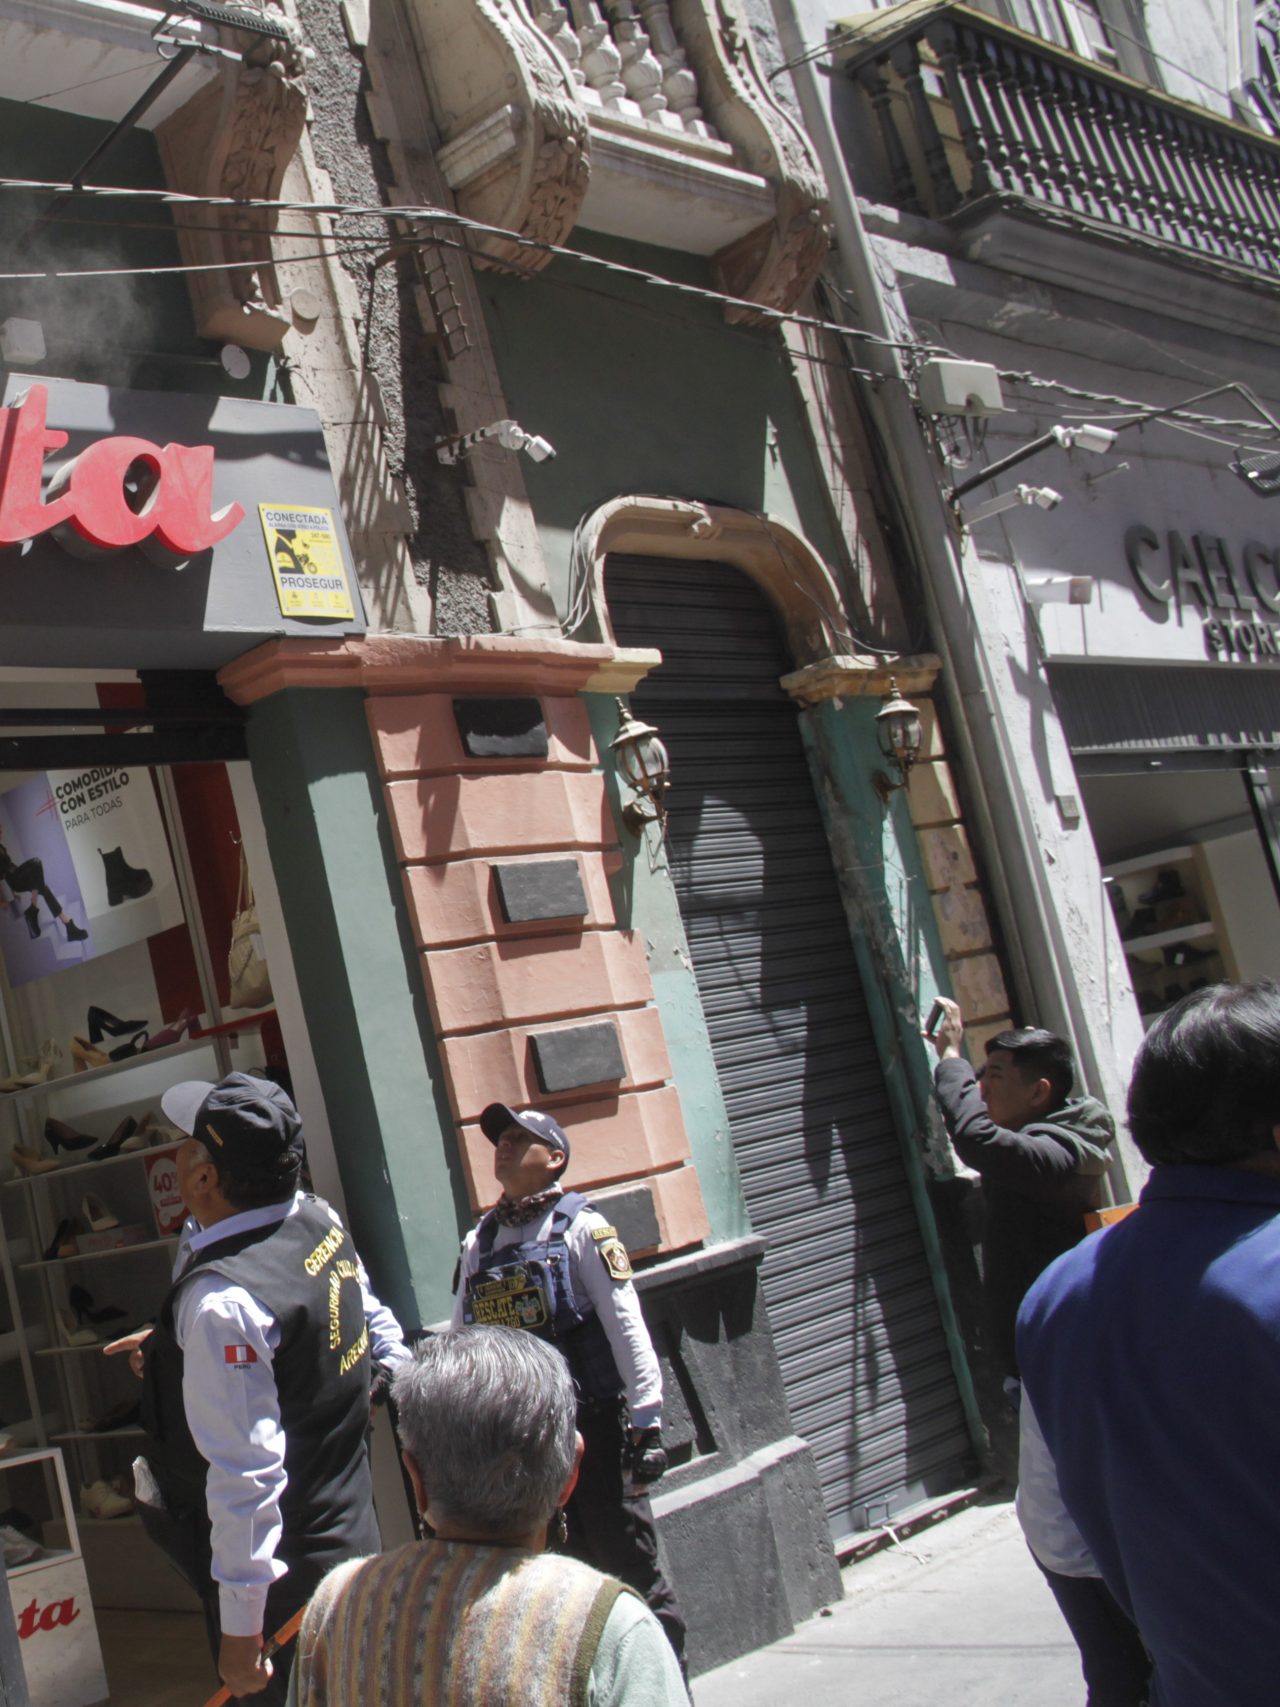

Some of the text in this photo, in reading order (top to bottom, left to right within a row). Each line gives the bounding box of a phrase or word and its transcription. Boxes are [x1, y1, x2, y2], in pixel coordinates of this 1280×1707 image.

[265, 511, 328, 526] CONECTADA
[280, 576, 344, 591] PROSEGUR
[1123, 524, 1280, 618] CAELC
[61, 772, 129, 814] CON ESTILO
[65, 796, 123, 831] PARA TODAS
[304, 1225, 345, 1277] GERENCIA
[329, 1269, 341, 1350] SEGURIDAD
[474, 1295, 515, 1322] RESCATE
